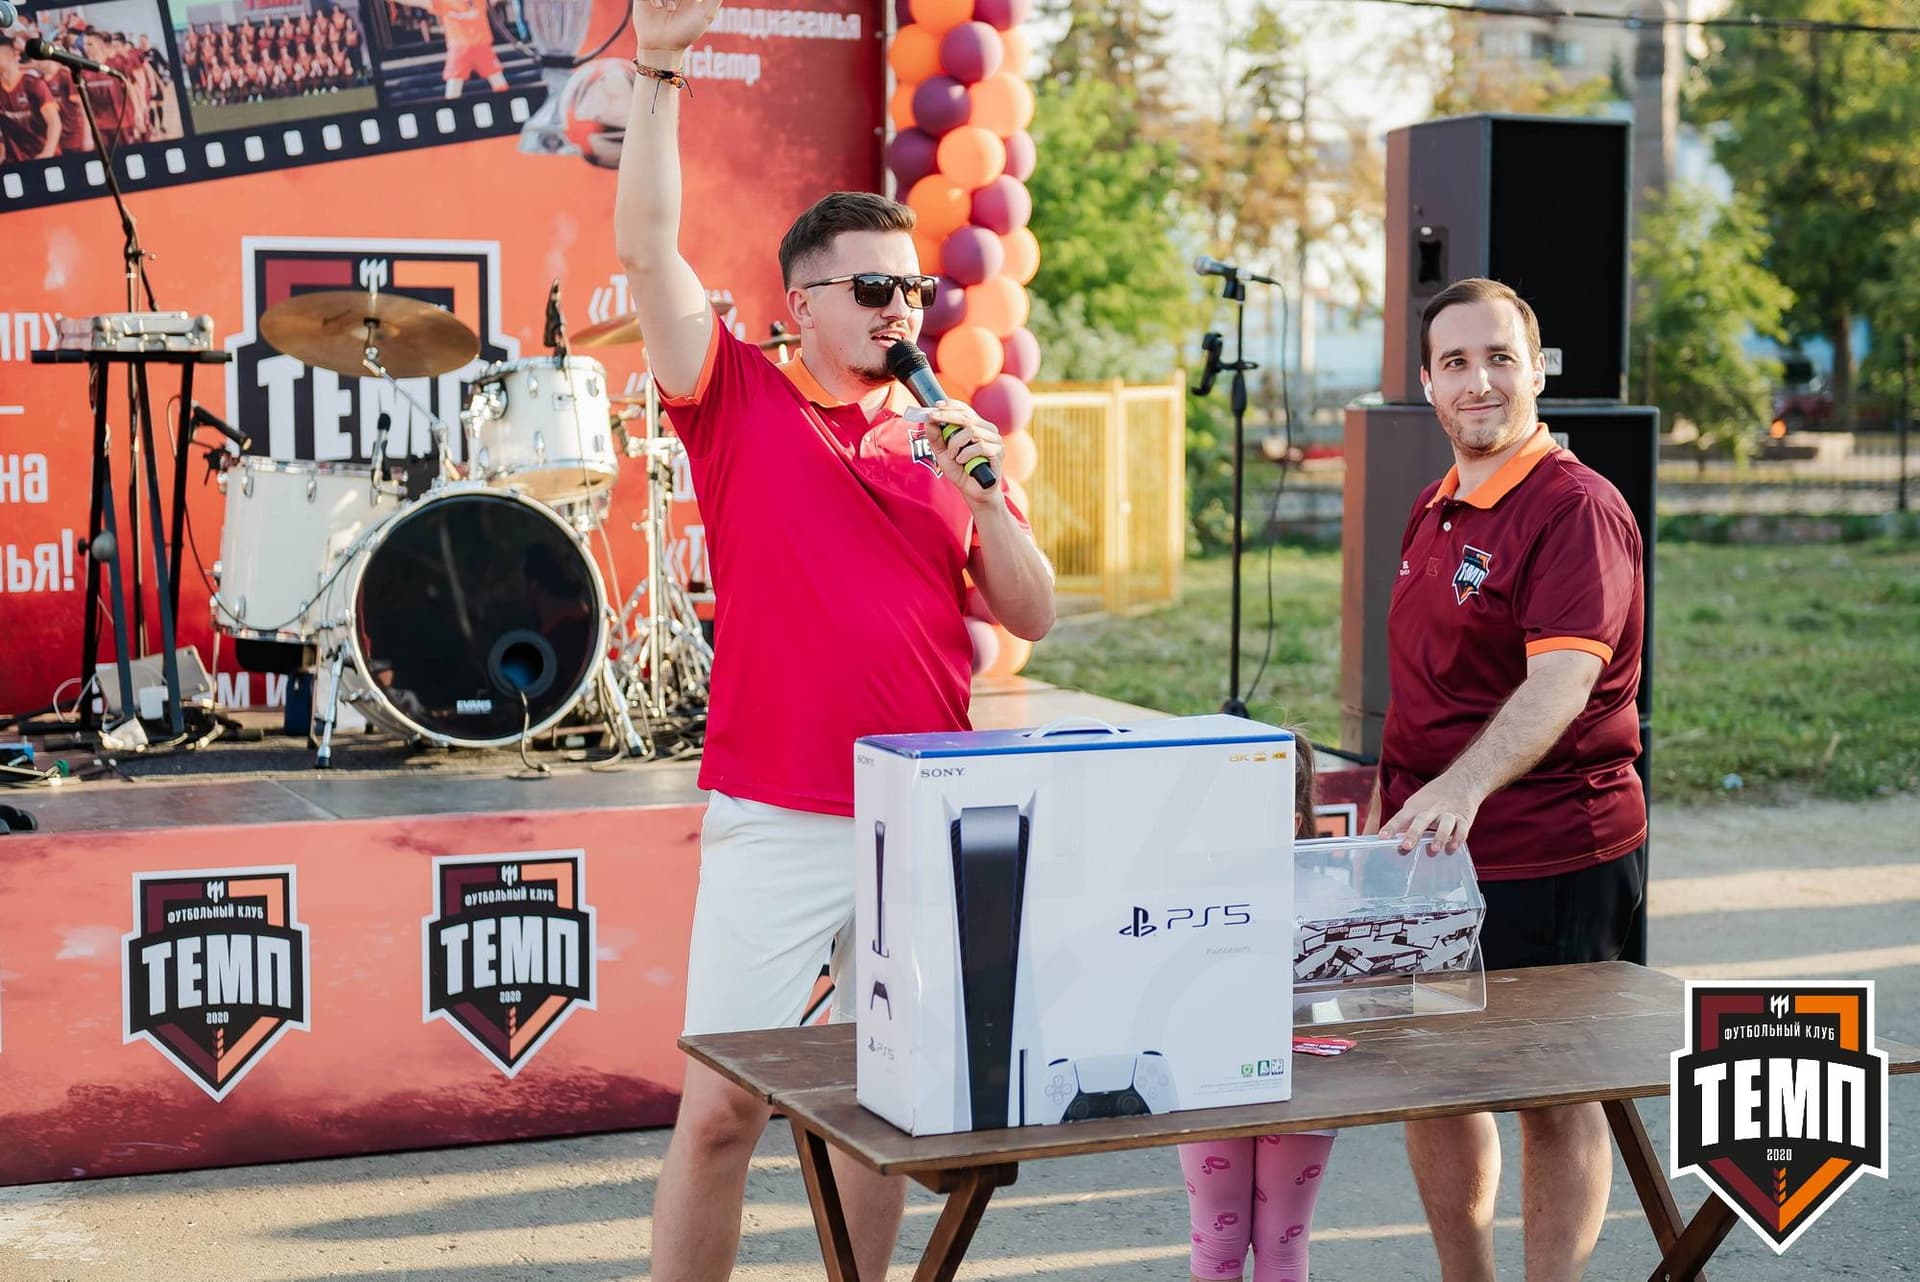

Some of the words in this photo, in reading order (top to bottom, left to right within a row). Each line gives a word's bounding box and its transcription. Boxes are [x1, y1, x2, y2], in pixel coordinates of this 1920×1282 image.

[0, 528, 75, 593] ья!
[920, 767, 967, 778] SONY
[464, 886, 527, 907] ФУТБОЛЬНЫЙ
[529, 887, 555, 902] КЛУБ
[168, 903, 234, 924] ФУТБОЛЬНЫЙ
[237, 905, 264, 919] КЛУБ
[1166, 903, 1251, 930] PS5
[440, 915, 579, 996] ТЕМП
[141, 934, 292, 1016] ТЕМП
[206, 1011, 229, 1024] 2020
